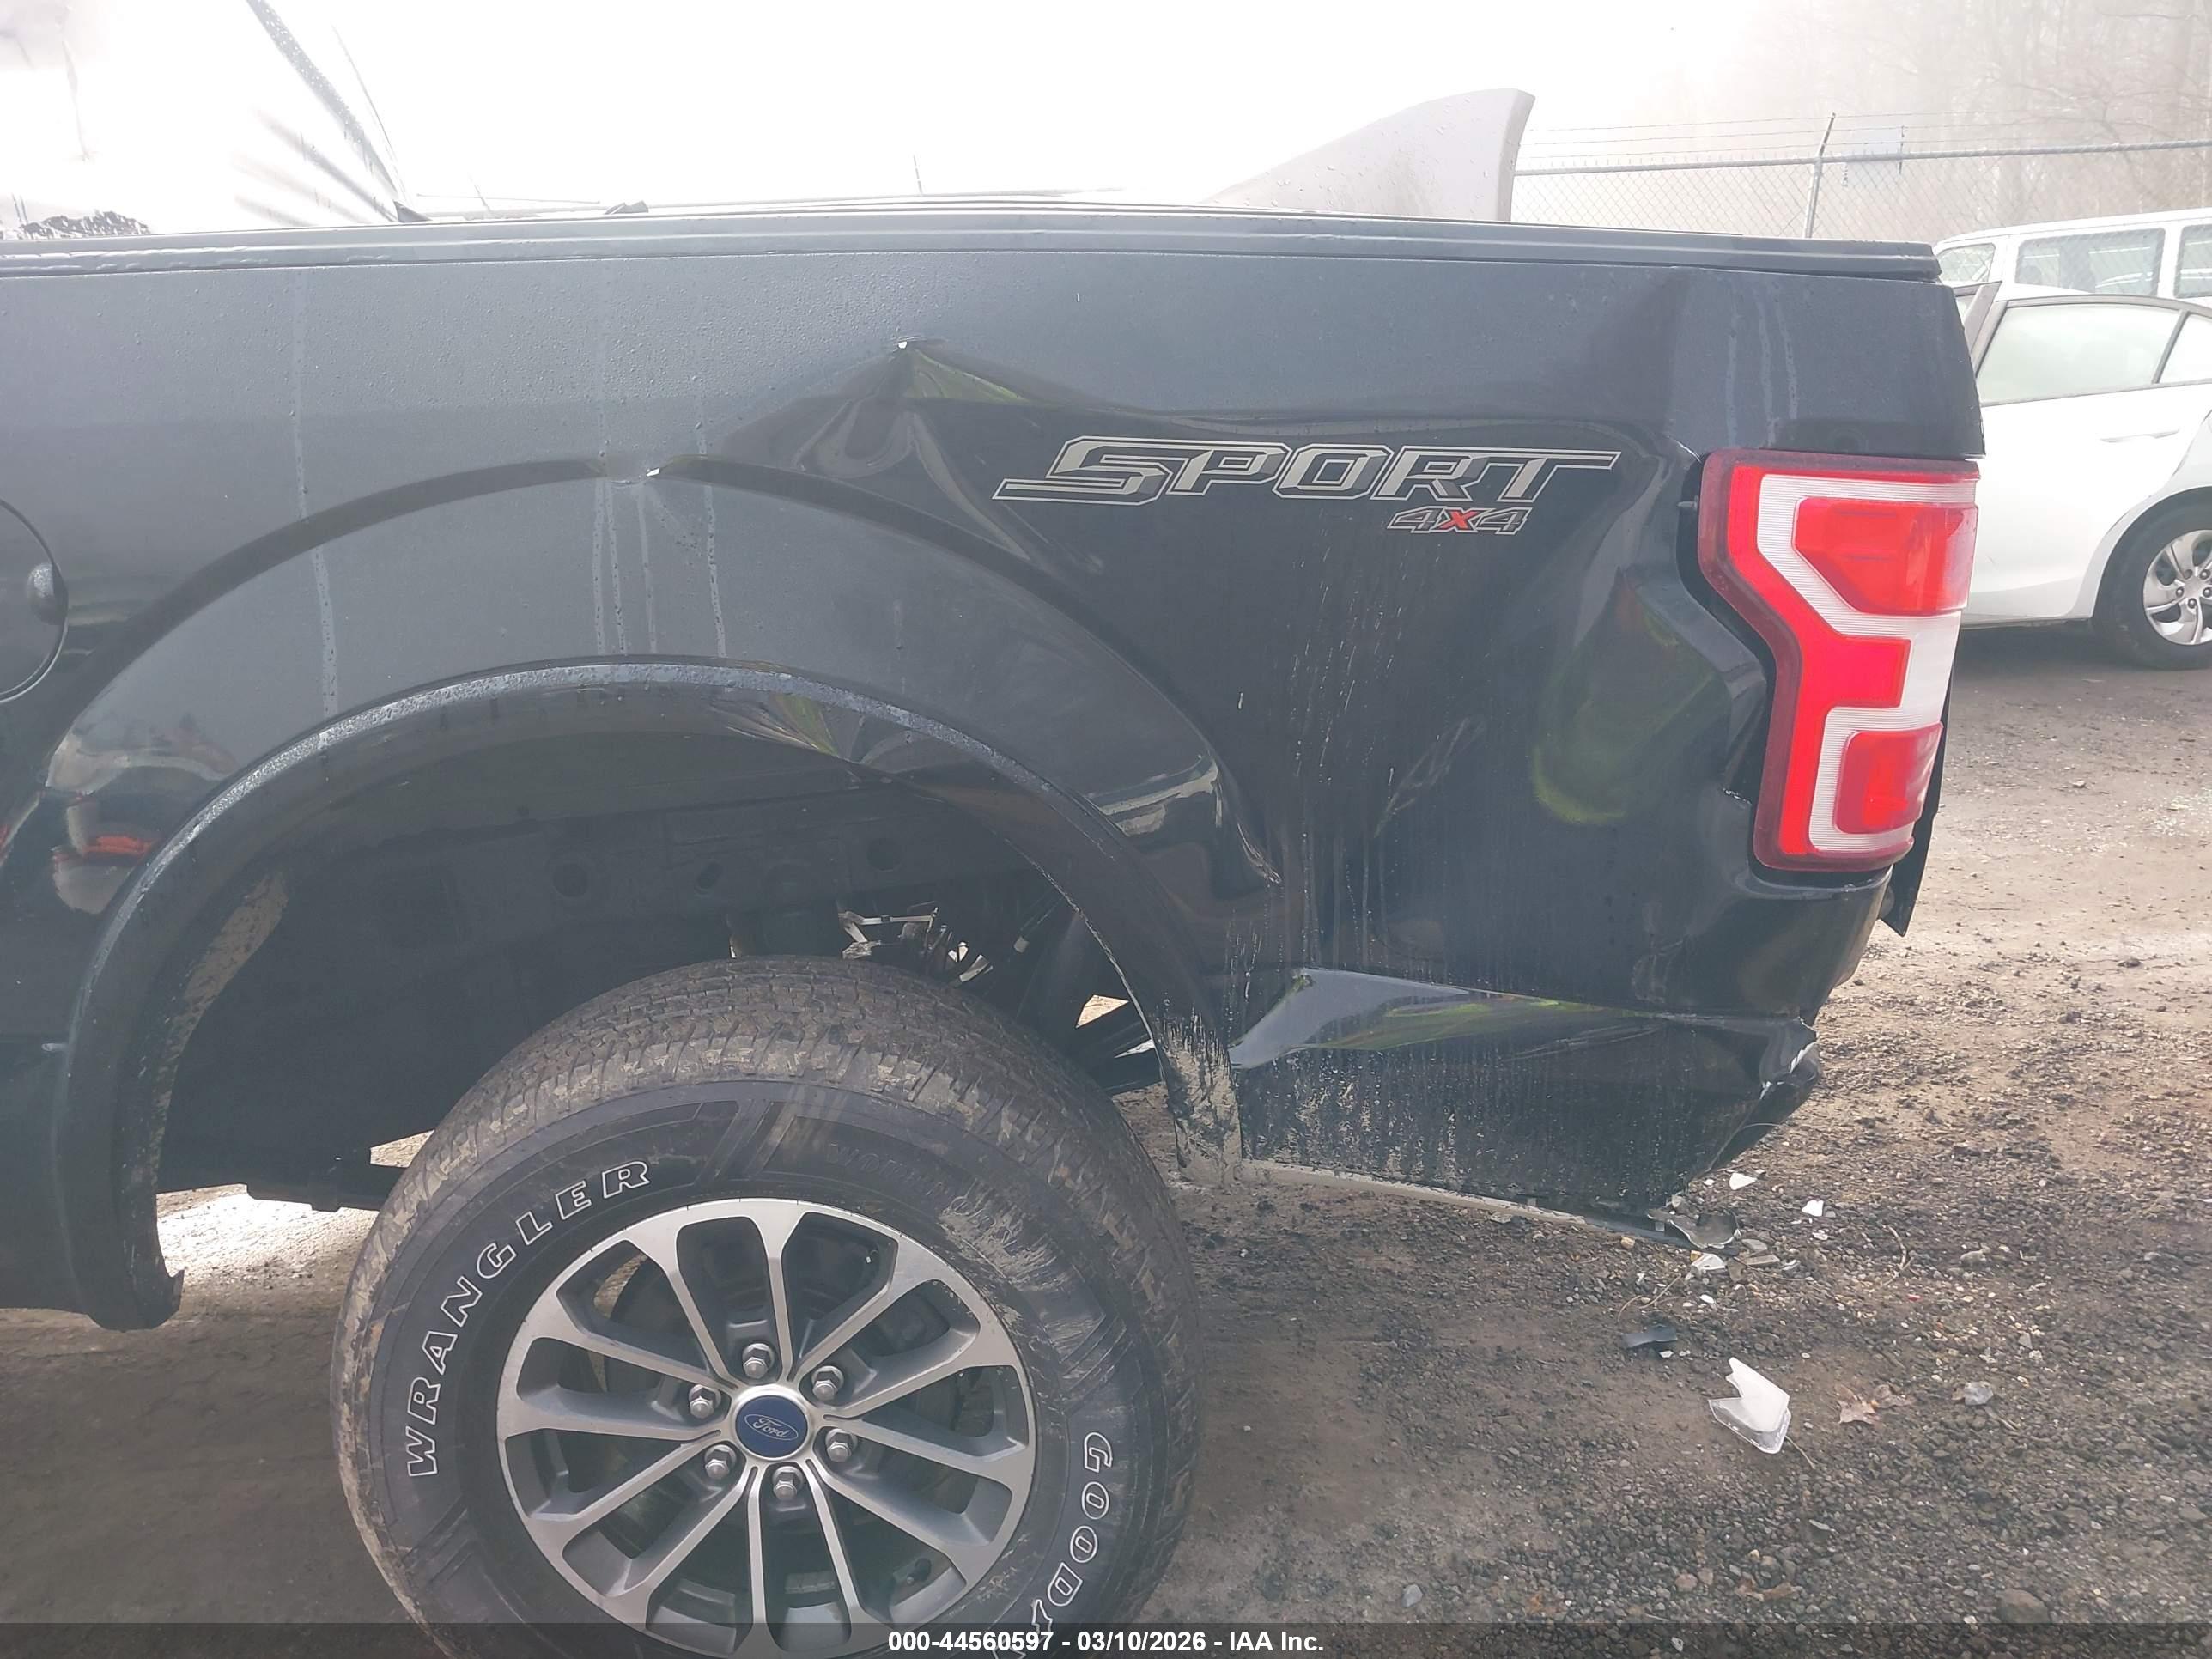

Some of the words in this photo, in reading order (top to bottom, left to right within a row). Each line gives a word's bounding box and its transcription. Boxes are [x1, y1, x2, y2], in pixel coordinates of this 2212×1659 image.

[992, 435, 1621, 505] SPORT
[406, 1161, 650, 1477] WRANGLER
[753, 1418, 790, 1438] Ford
